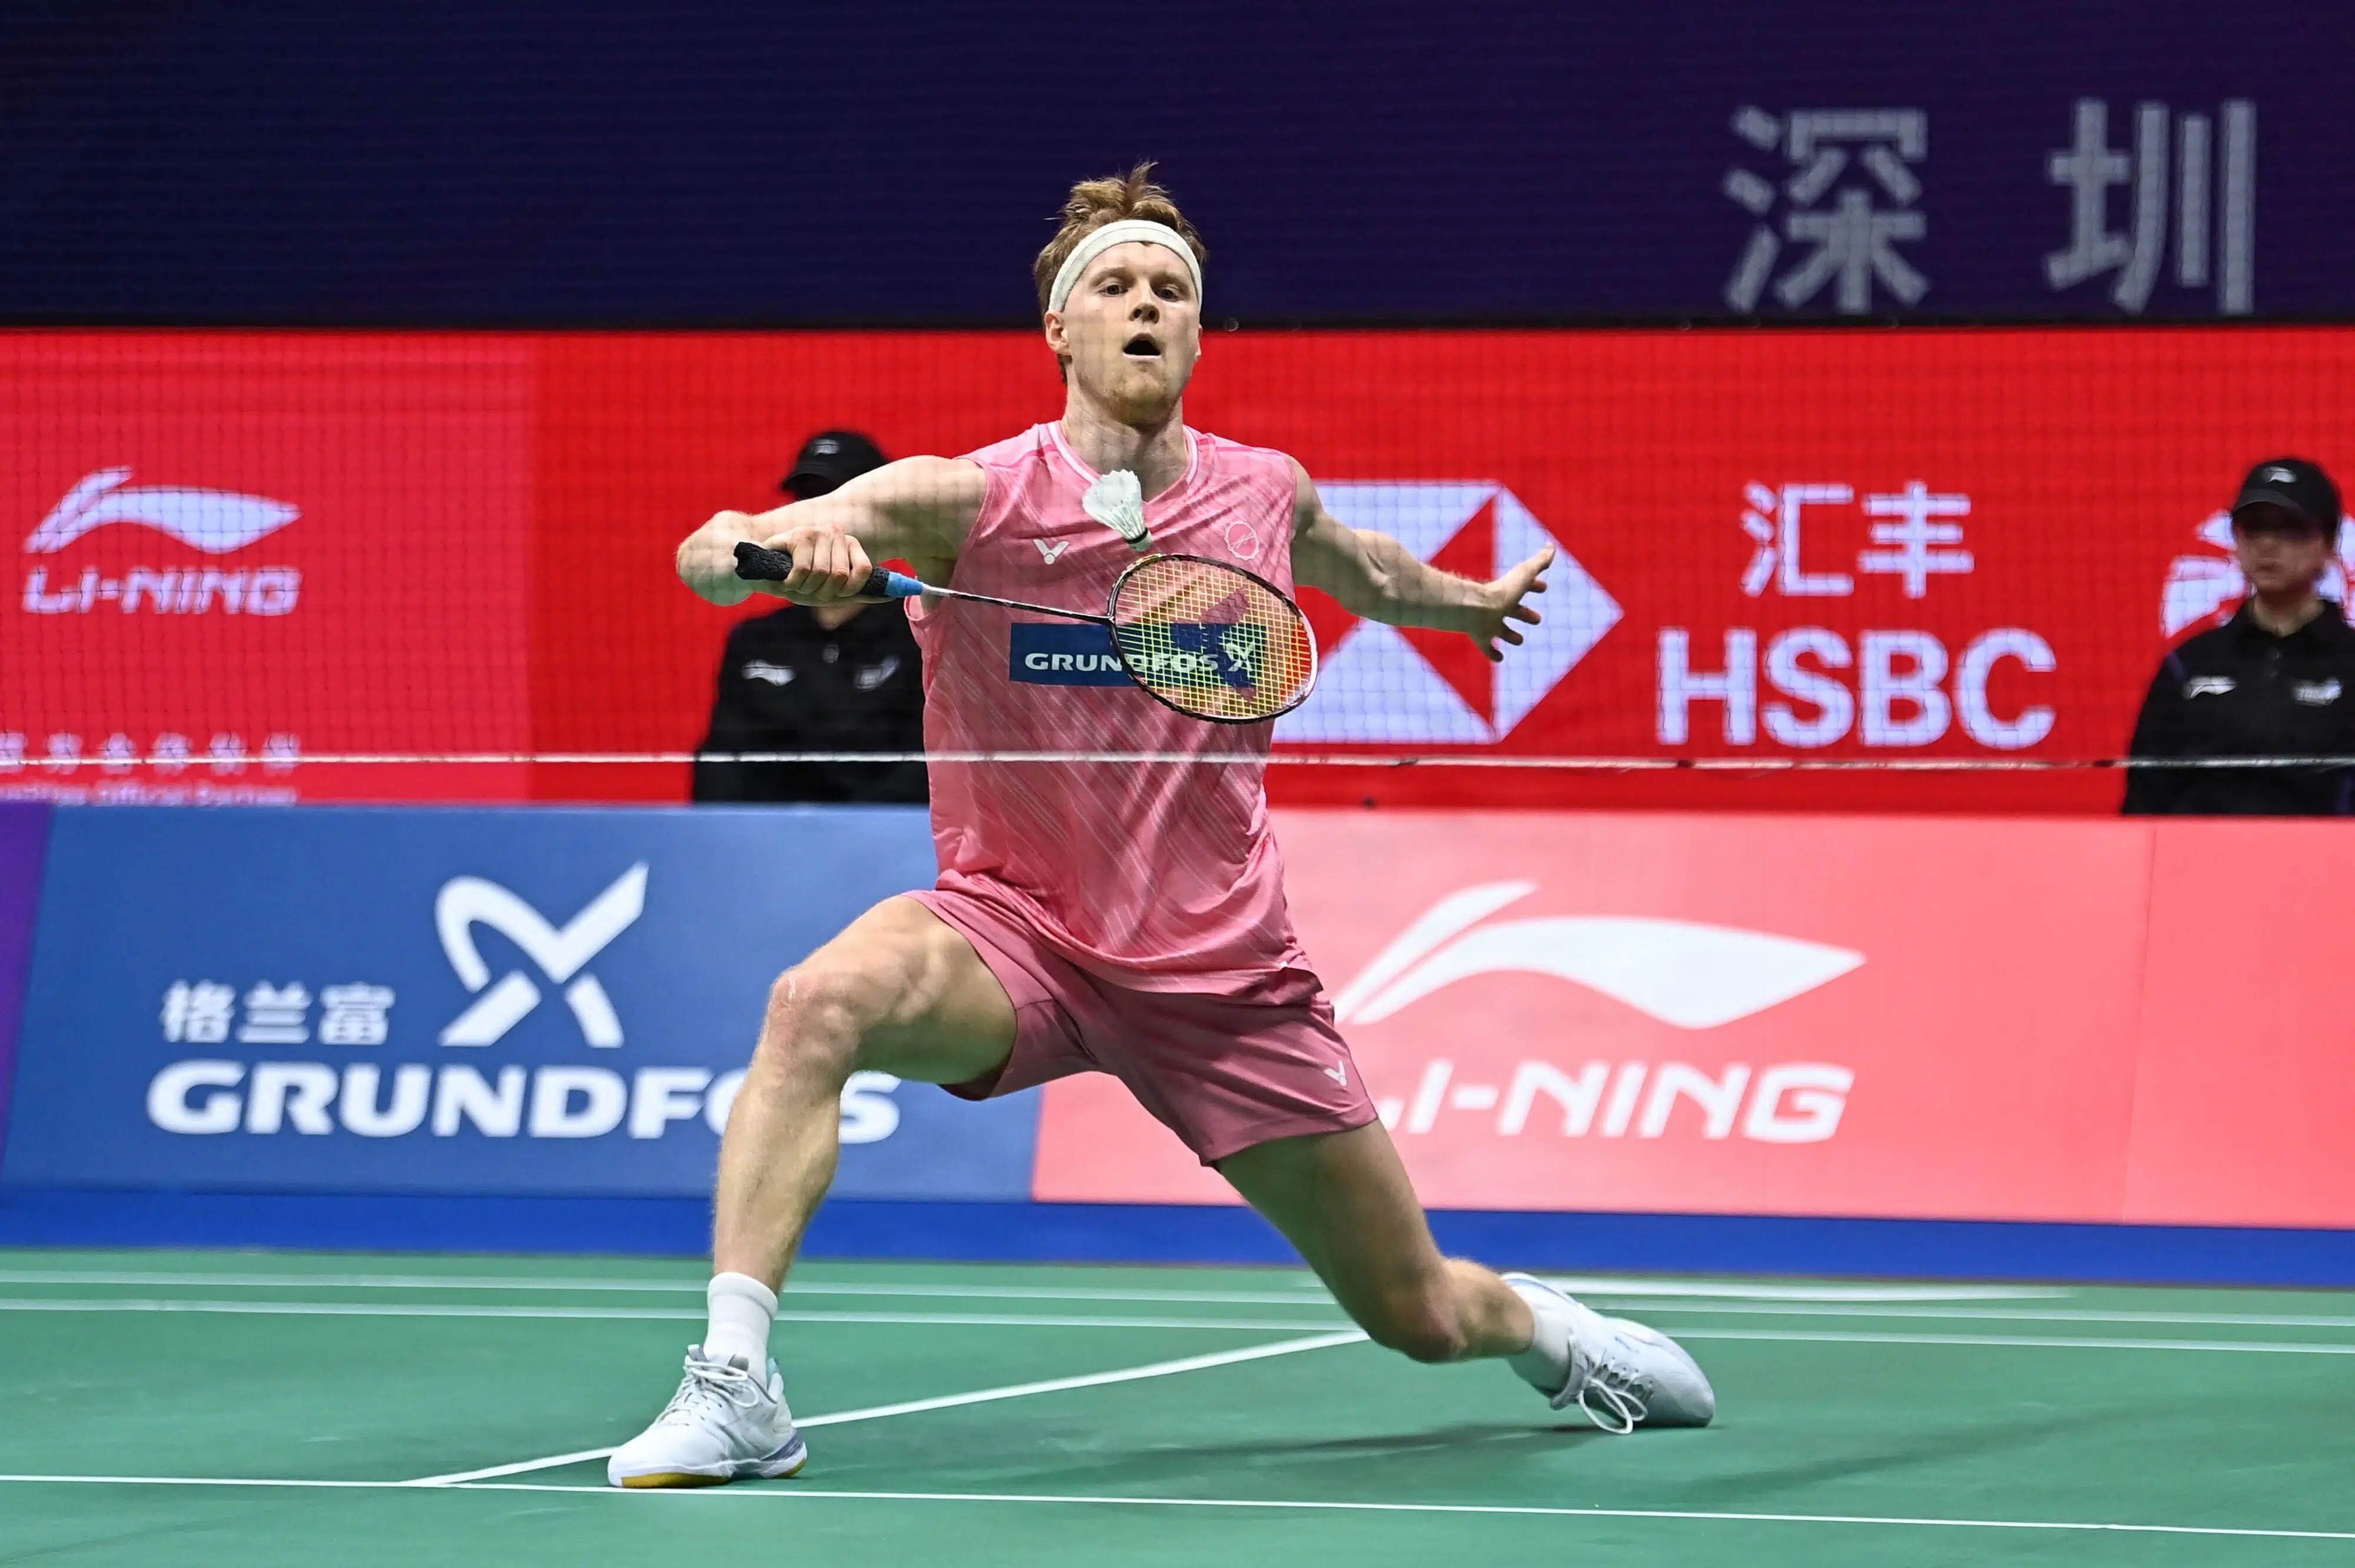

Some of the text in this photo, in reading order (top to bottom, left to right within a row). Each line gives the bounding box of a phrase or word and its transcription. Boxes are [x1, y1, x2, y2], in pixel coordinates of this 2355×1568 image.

[1723, 98, 2256, 315] 深圳
[1741, 480, 1975, 599] 汇丰
[1656, 627, 2057, 749] HSBC
[161, 981, 395, 1045] 格兰富
